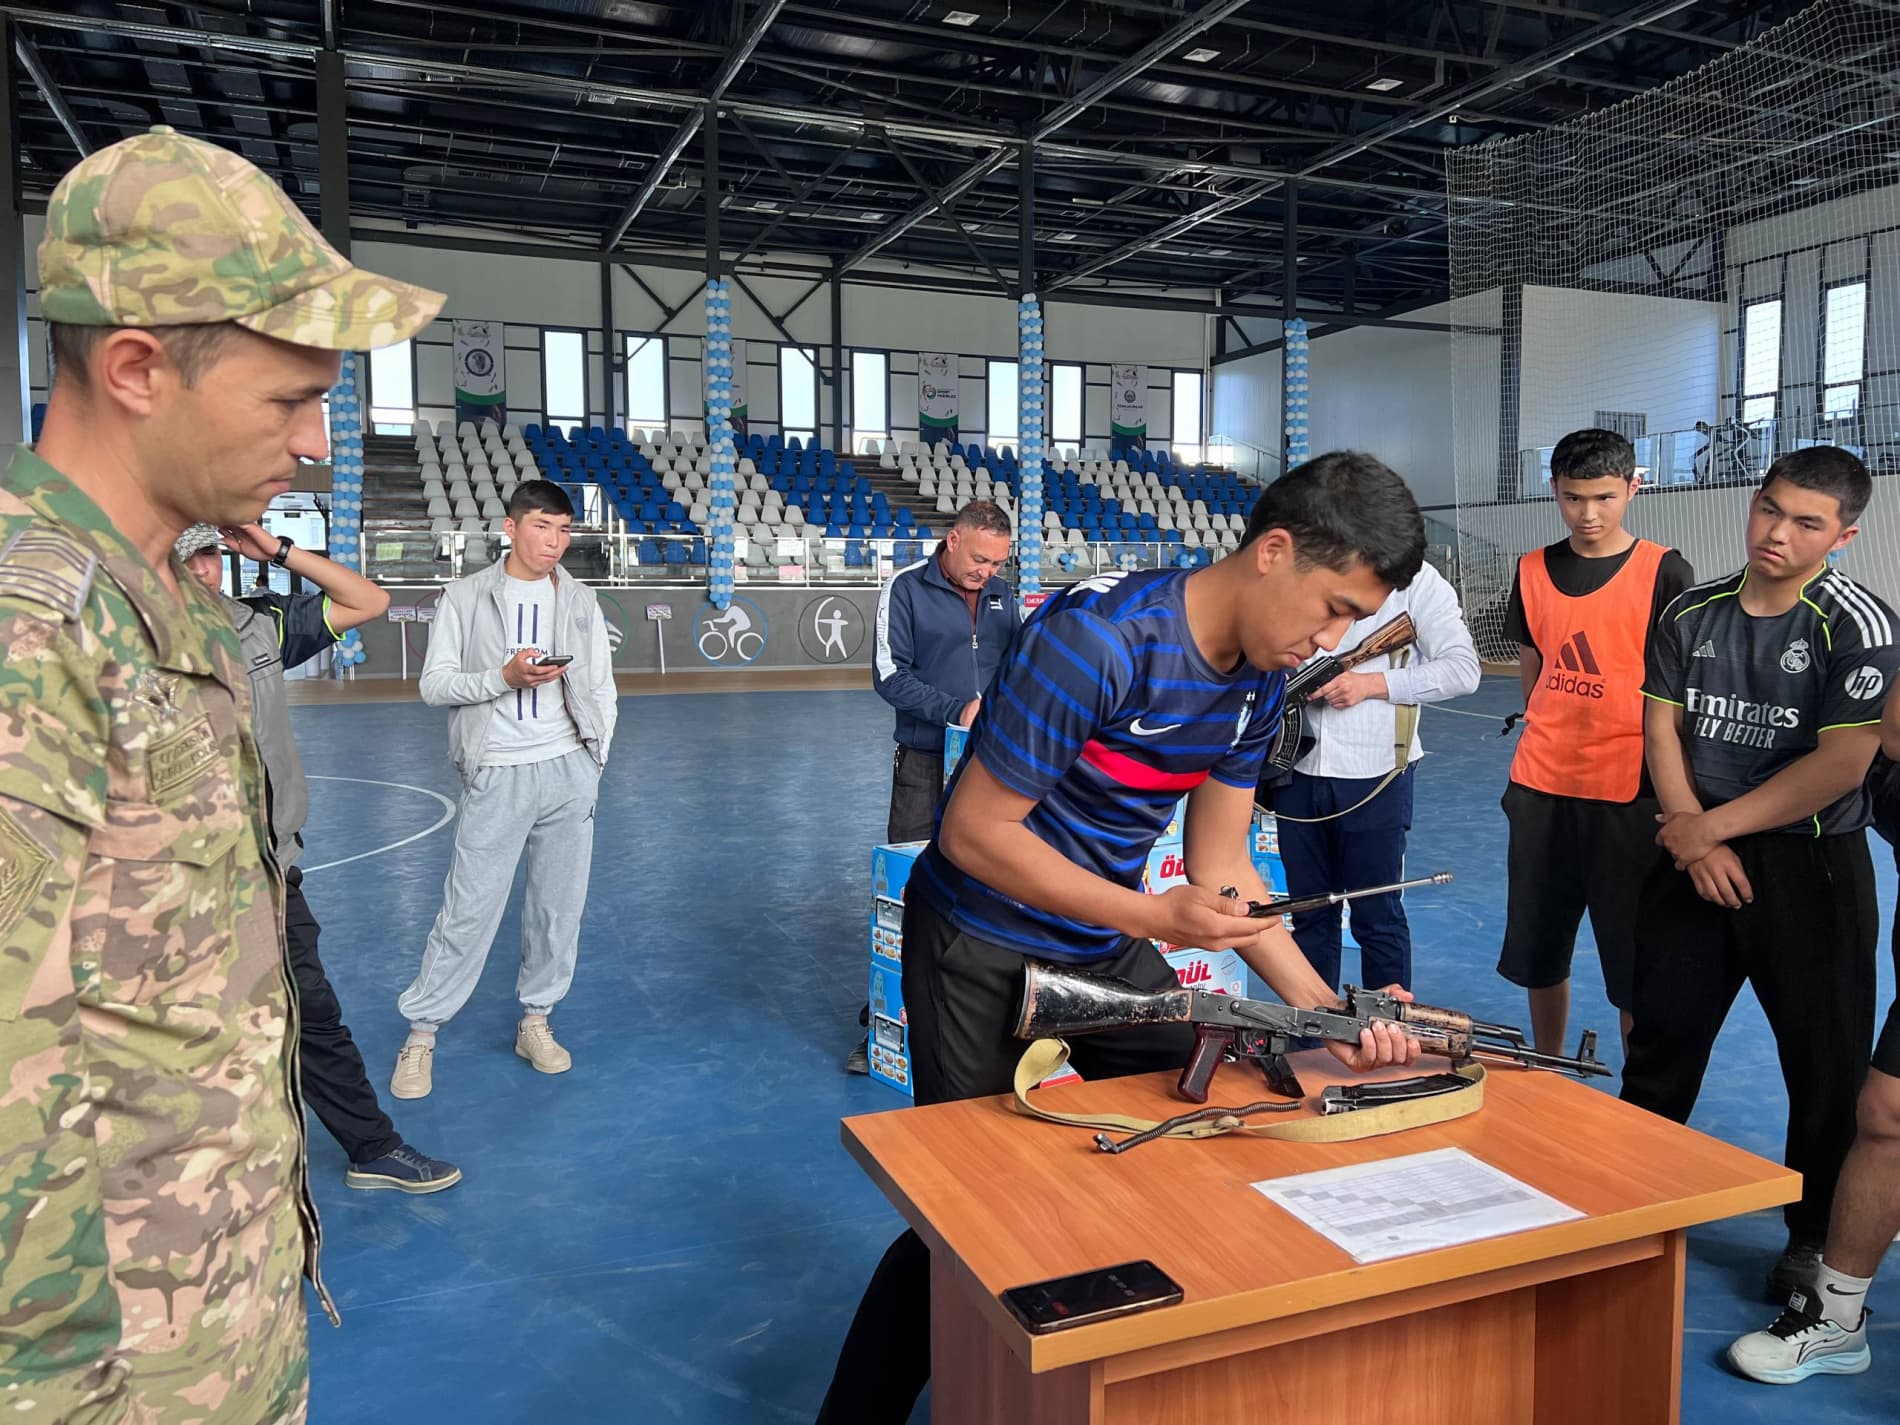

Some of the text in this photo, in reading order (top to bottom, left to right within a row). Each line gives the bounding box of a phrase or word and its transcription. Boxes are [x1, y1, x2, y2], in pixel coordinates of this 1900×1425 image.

[1846, 666, 1882, 700] hp
[1686, 688, 1800, 728] Emirates
[1694, 716, 1776, 750] FLY BETTER
